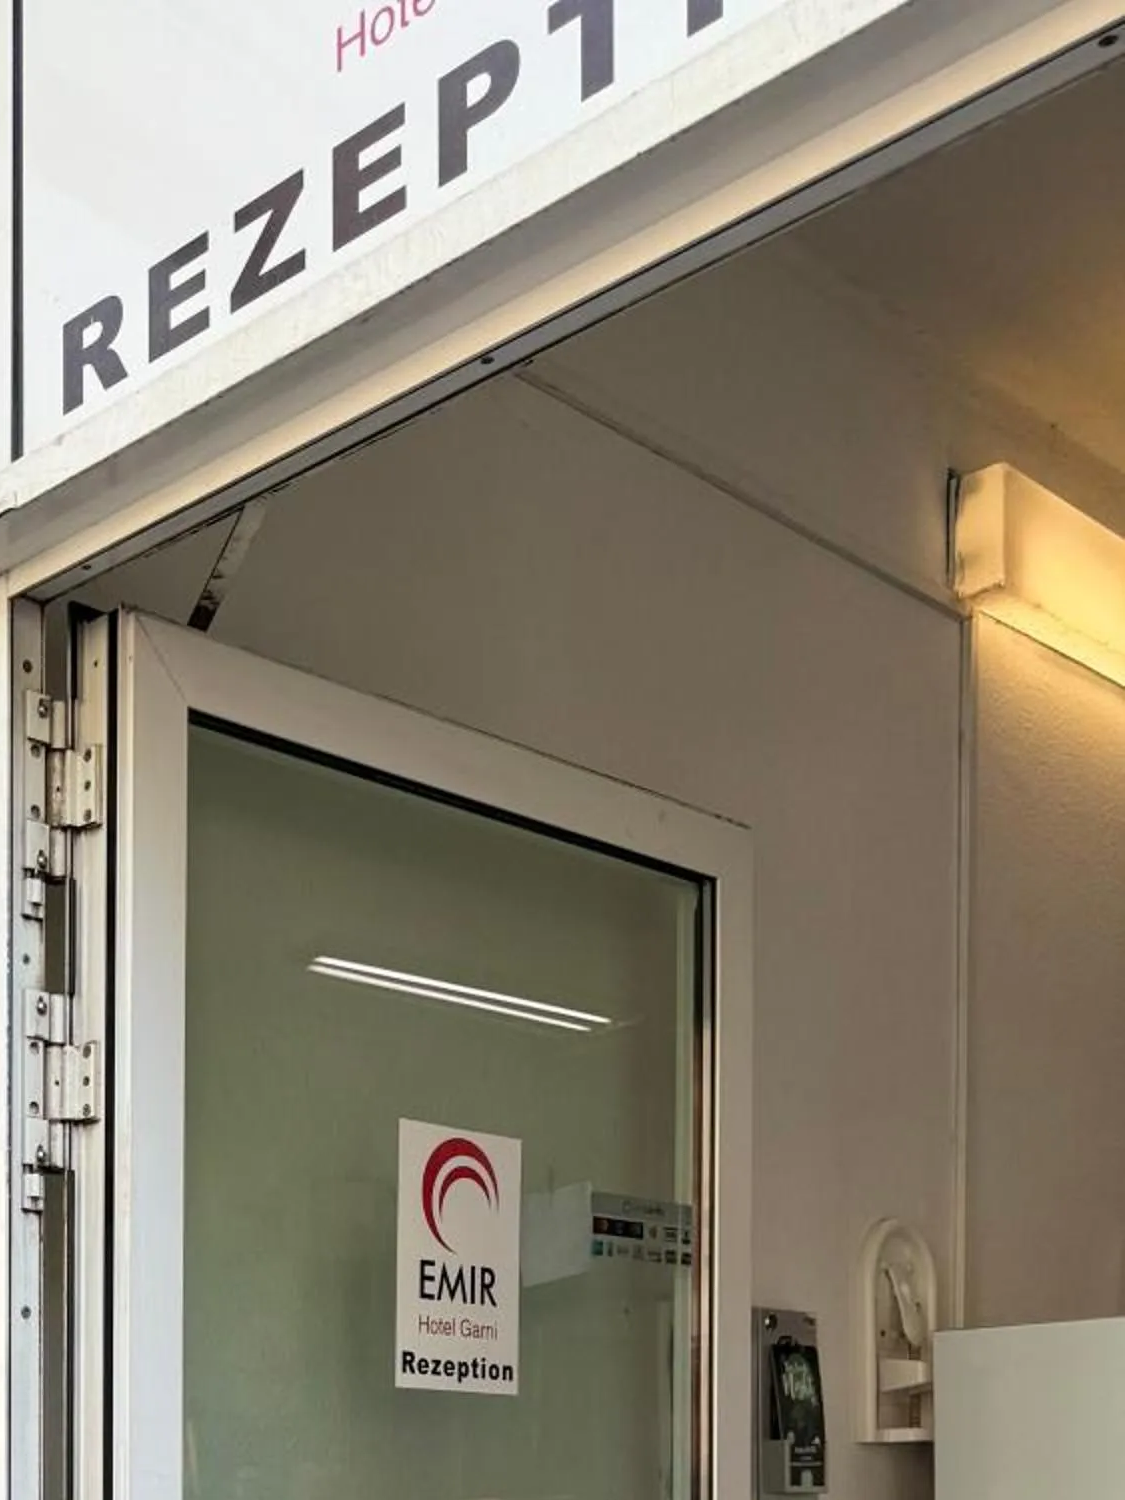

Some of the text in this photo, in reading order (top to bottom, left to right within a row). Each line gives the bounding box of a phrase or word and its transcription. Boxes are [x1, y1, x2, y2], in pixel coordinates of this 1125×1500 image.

[419, 1259, 497, 1307] EMIR
[418, 1314, 498, 1340] Hotel Garni
[402, 1350, 514, 1383] Rezeption
